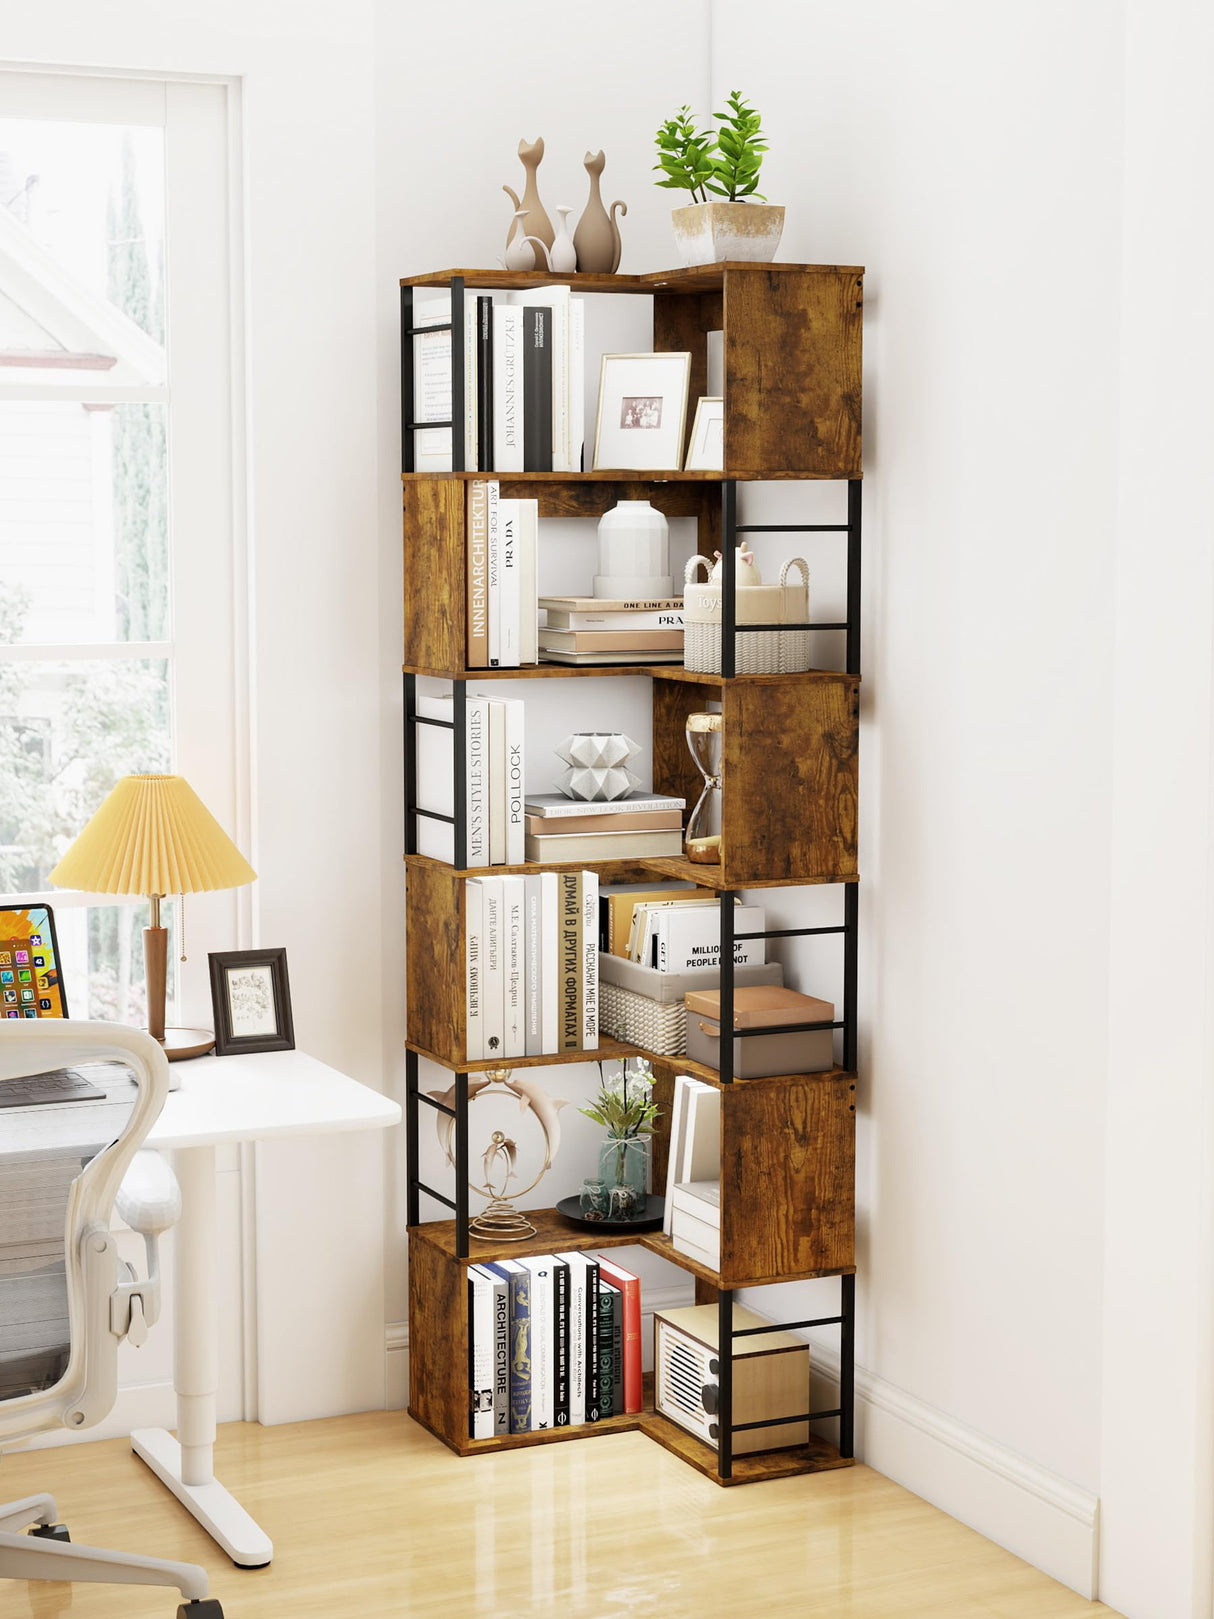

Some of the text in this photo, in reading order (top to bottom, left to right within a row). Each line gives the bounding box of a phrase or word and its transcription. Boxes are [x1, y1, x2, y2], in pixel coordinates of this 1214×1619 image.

[490, 486, 498, 588] ART FOR SURVIVAL
[505, 519, 513, 568] PRADA
[472, 479, 485, 638] INNENARCHITEKTUR
[658, 616, 685, 625] PRA
[673, 601, 685, 609] DA
[697, 594, 722, 613] Toys
[470, 709, 482, 857] MEN'S STYLE STORIES
[511, 744, 521, 824] POLLOCK
[488, 898, 497, 926] ДАНТЕ
[564, 875, 580, 915] ДУМАЙ
[564, 930, 577, 973] ДРУГИХ
[586, 943, 595, 985] РАССКАЖИ
[686, 957, 717, 967] PEOPLE
[564, 977, 577, 1037] ФОРМАТАХ
[586, 988, 595, 1005] МНЕ
[586, 1015, 595, 1037] МОРЕ
[497, 1293, 507, 1395] ARCHITECTURE
